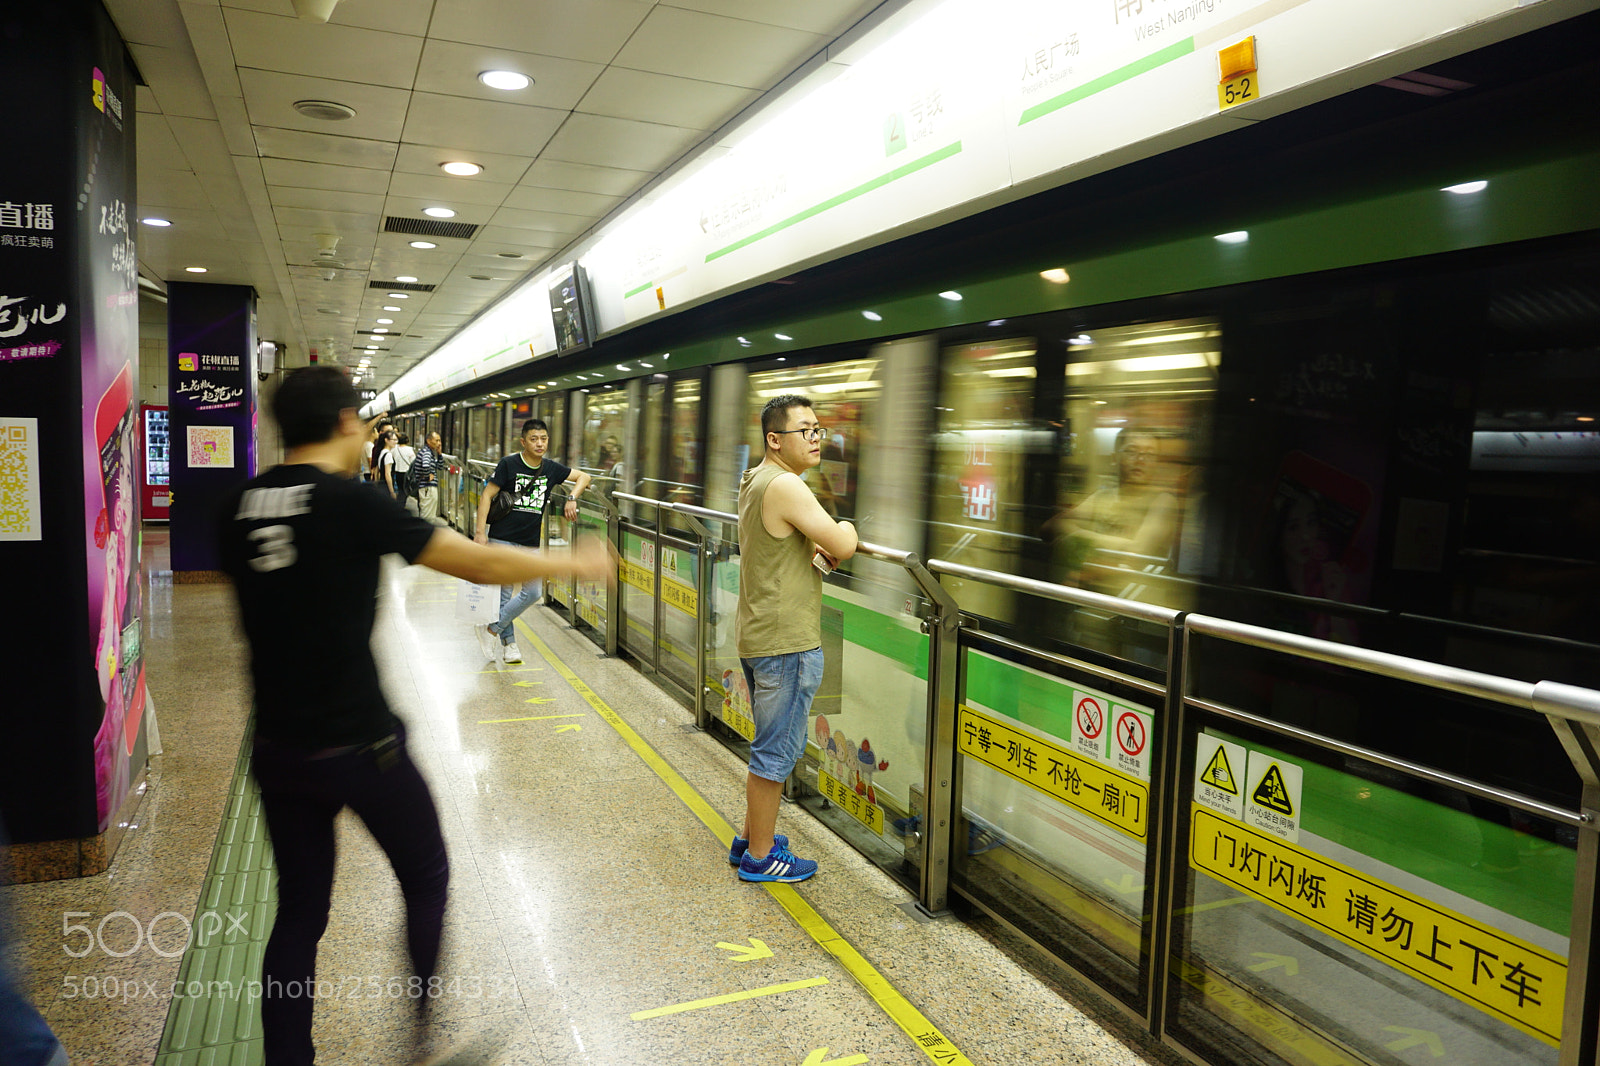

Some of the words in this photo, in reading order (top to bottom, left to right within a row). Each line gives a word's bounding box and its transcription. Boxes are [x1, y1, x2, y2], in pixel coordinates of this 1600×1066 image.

[1134, 17, 1164, 41] West
[1167, 0, 1214, 27] Nanjing
[1021, 32, 1080, 81] 人民广场
[1225, 78, 1252, 104] 5-2
[888, 111, 900, 142] 2
[1, 234, 54, 249] 疯狂卖萌
[202, 355, 239, 365] 花椒直播
[247, 525, 298, 573] 3
[1078, 737, 1099, 751] 禁止吸烟
[964, 721, 1037, 774] 宁等一列车
[1047, 757, 1140, 823] 不抢一扇门
[1199, 795, 1211, 804] Mind
[1211, 800, 1221, 809] your
[1221, 804, 1237, 815] hands
[1204, 787, 1232, 804] 当心夹手
[1249, 805, 1295, 831] 小心站台间隙
[1213, 830, 1327, 909] 门灯闪烁
[1345, 888, 1542, 1009] 请勿上下车
[916, 1031, 958, 1065] 请小
